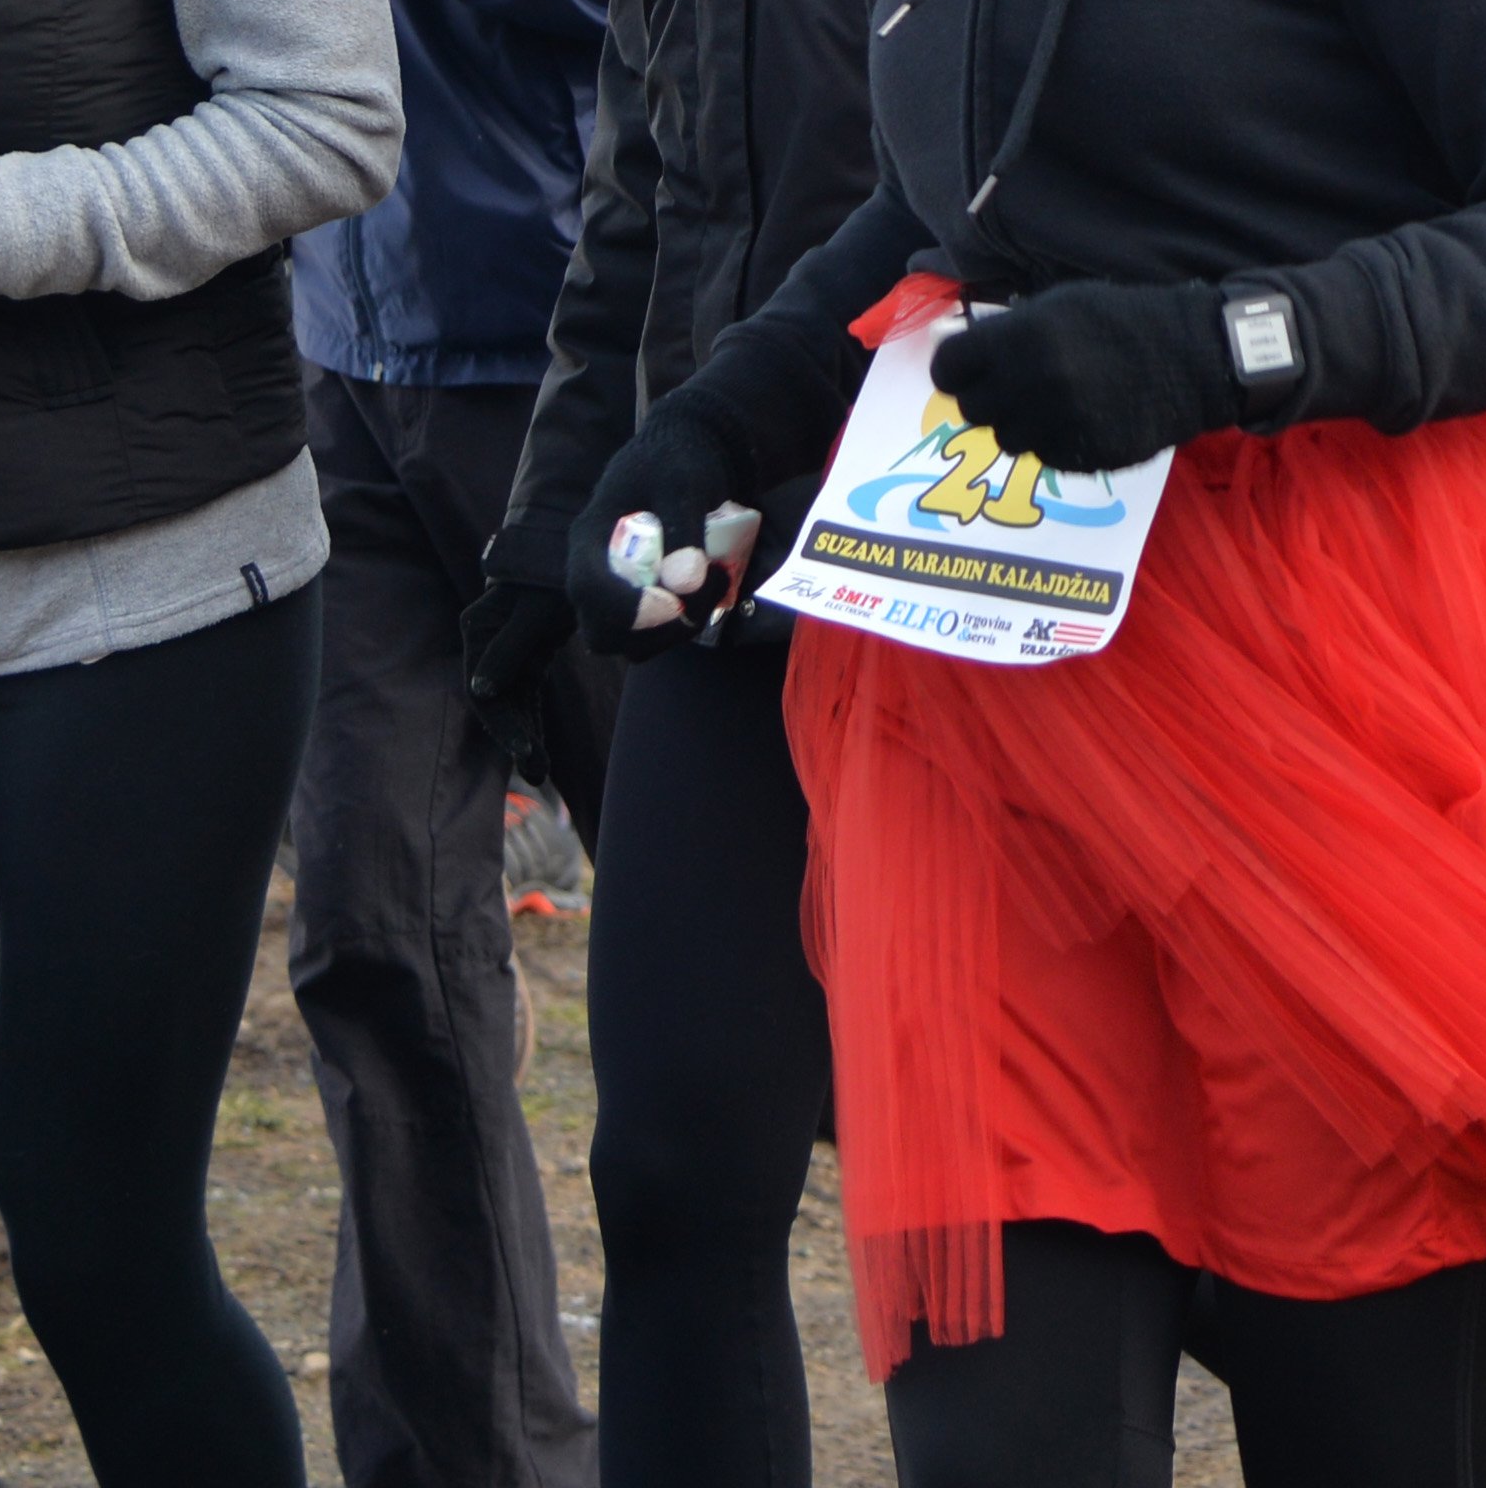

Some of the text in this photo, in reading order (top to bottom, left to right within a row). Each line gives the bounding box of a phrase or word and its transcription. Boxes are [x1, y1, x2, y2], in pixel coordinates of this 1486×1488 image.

[916, 425, 1044, 528] 21
[814, 531, 1111, 604] SUZANA VARADIN KALAJDŽIJA
[833, 584, 883, 609] ŠMIT
[881, 599, 959, 637] ELFO
[963, 612, 1012, 631] trgovina
